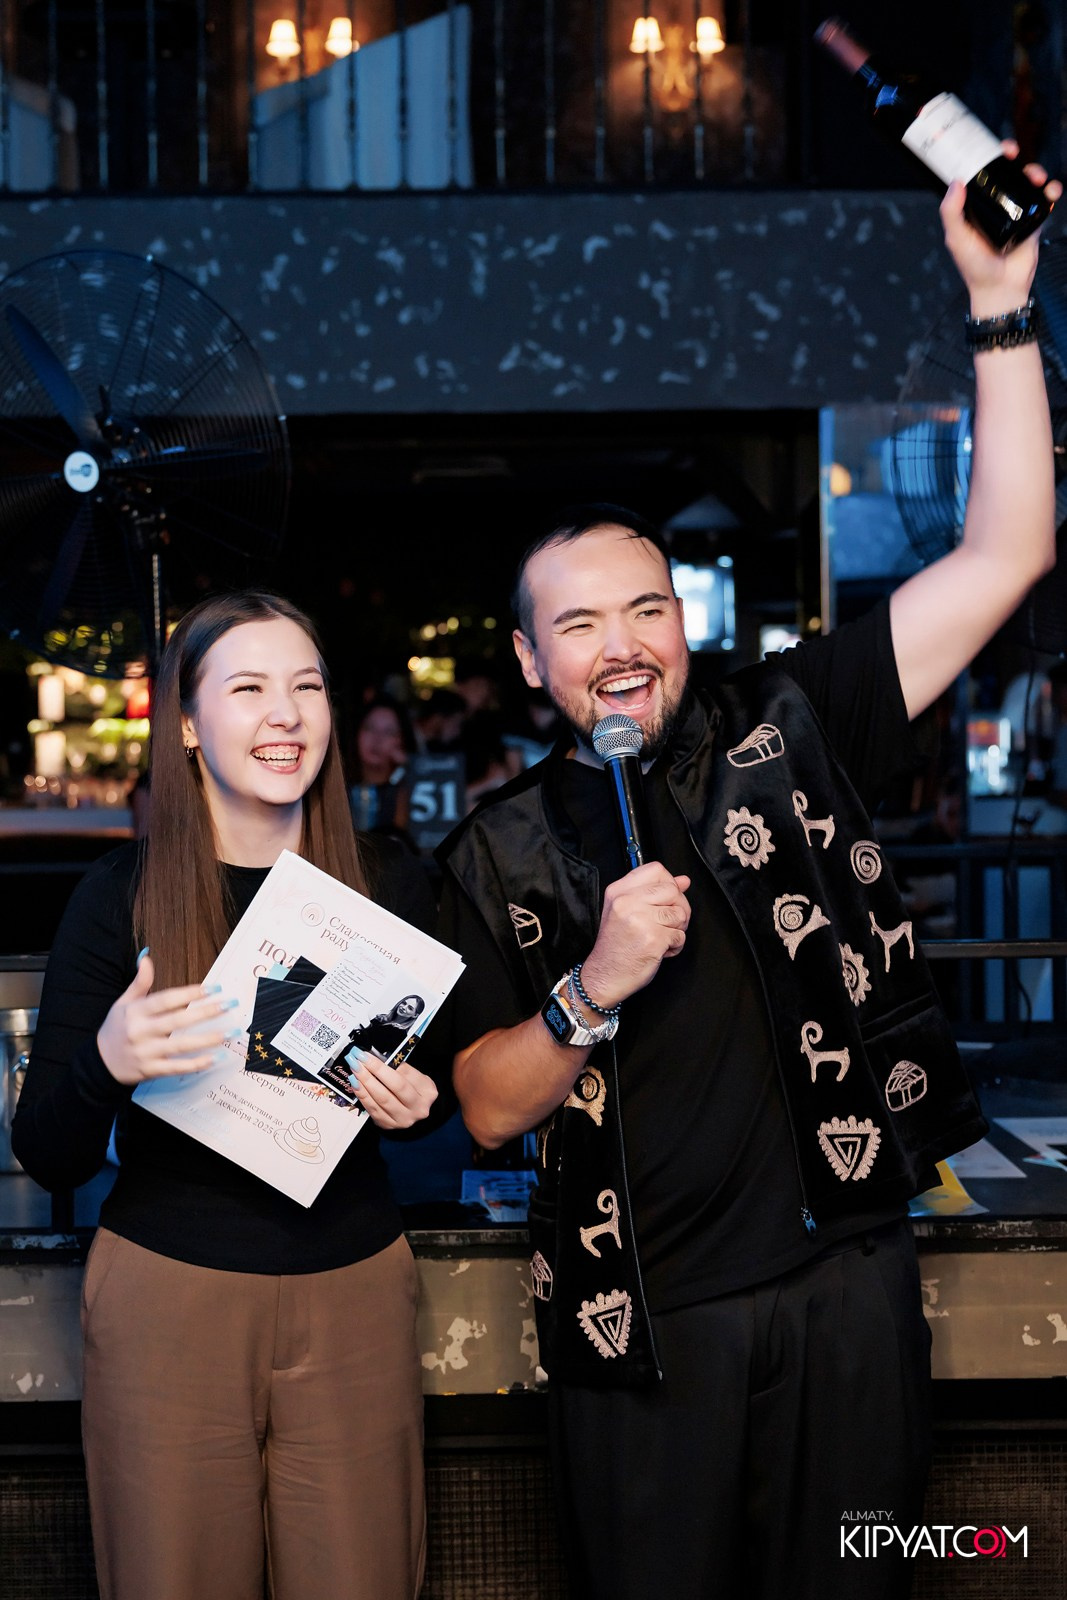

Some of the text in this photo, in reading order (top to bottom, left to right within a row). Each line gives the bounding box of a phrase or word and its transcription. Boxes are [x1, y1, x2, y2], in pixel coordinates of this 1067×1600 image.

[410, 781, 457, 822] 51
[320, 928, 349, 952] раду
[321, 1008, 347, 1030] -20%
[239, 1068, 286, 1098] десертов
[206, 1090, 217, 1101] 31
[216, 1099, 252, 1123] декабря
[252, 1118, 273, 1134] 2025
[219, 1083, 238, 1100] Срок
[274, 1118, 283, 1127] до
